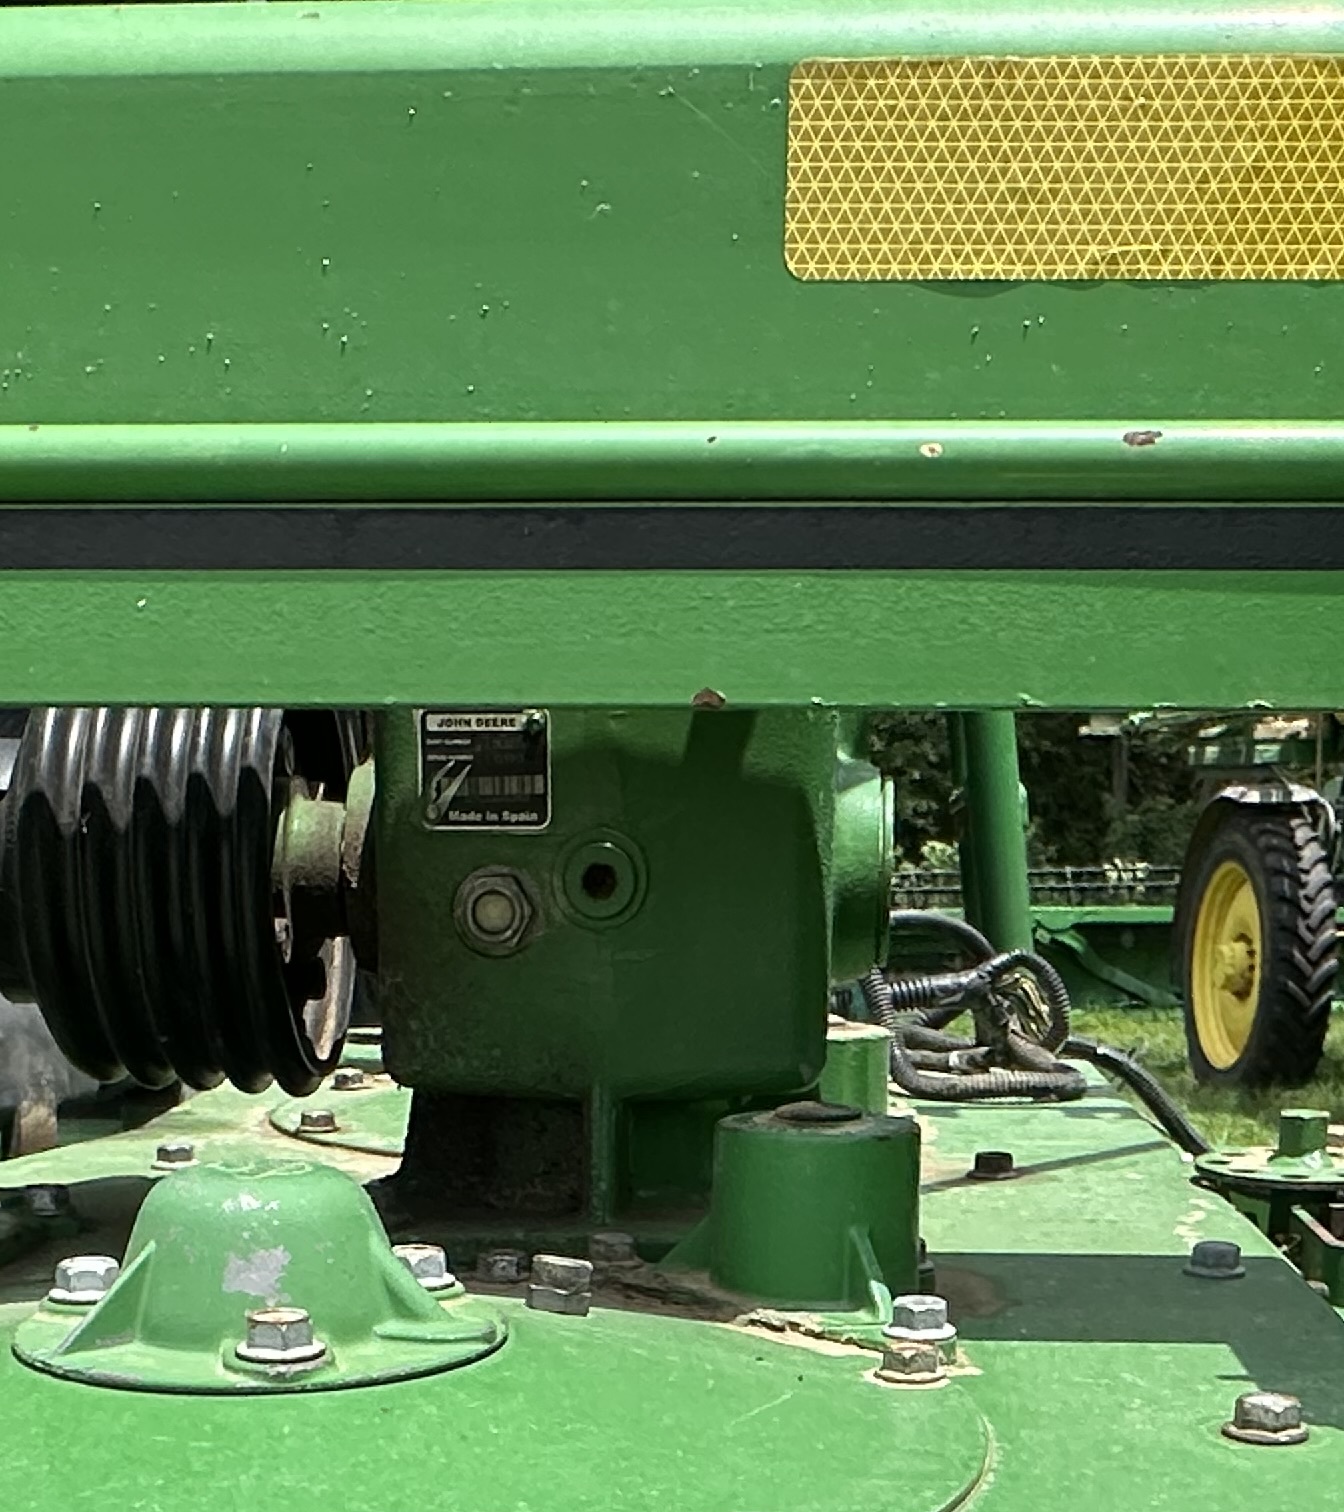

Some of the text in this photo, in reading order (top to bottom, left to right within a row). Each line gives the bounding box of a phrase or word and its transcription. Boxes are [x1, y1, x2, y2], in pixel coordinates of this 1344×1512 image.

[436, 718, 517, 728] JOHN DEERE
[448, 810, 482, 821] Made
[502, 810, 538, 823] Spain
